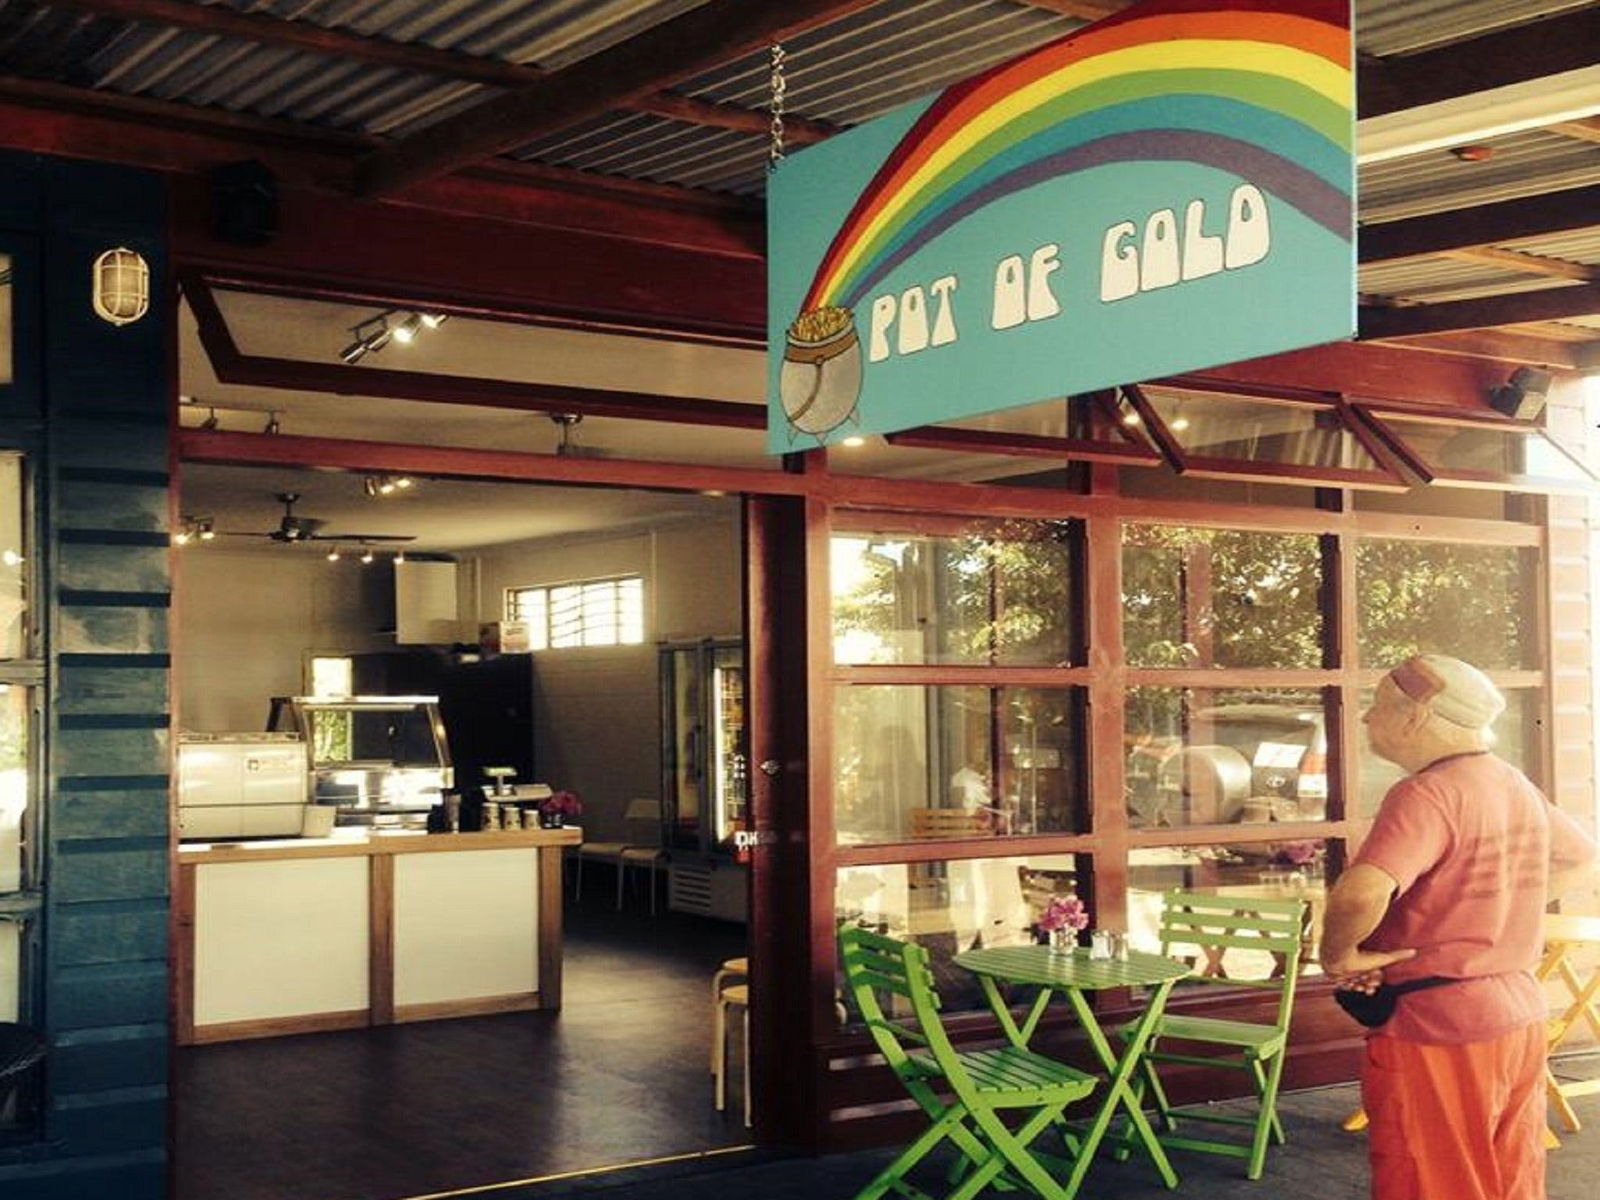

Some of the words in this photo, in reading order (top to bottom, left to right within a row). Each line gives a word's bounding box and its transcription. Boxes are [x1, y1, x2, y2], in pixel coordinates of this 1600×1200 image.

[869, 275, 958, 363] POT
[991, 243, 1062, 331] OF
[1100, 183, 1271, 303] GOLD
